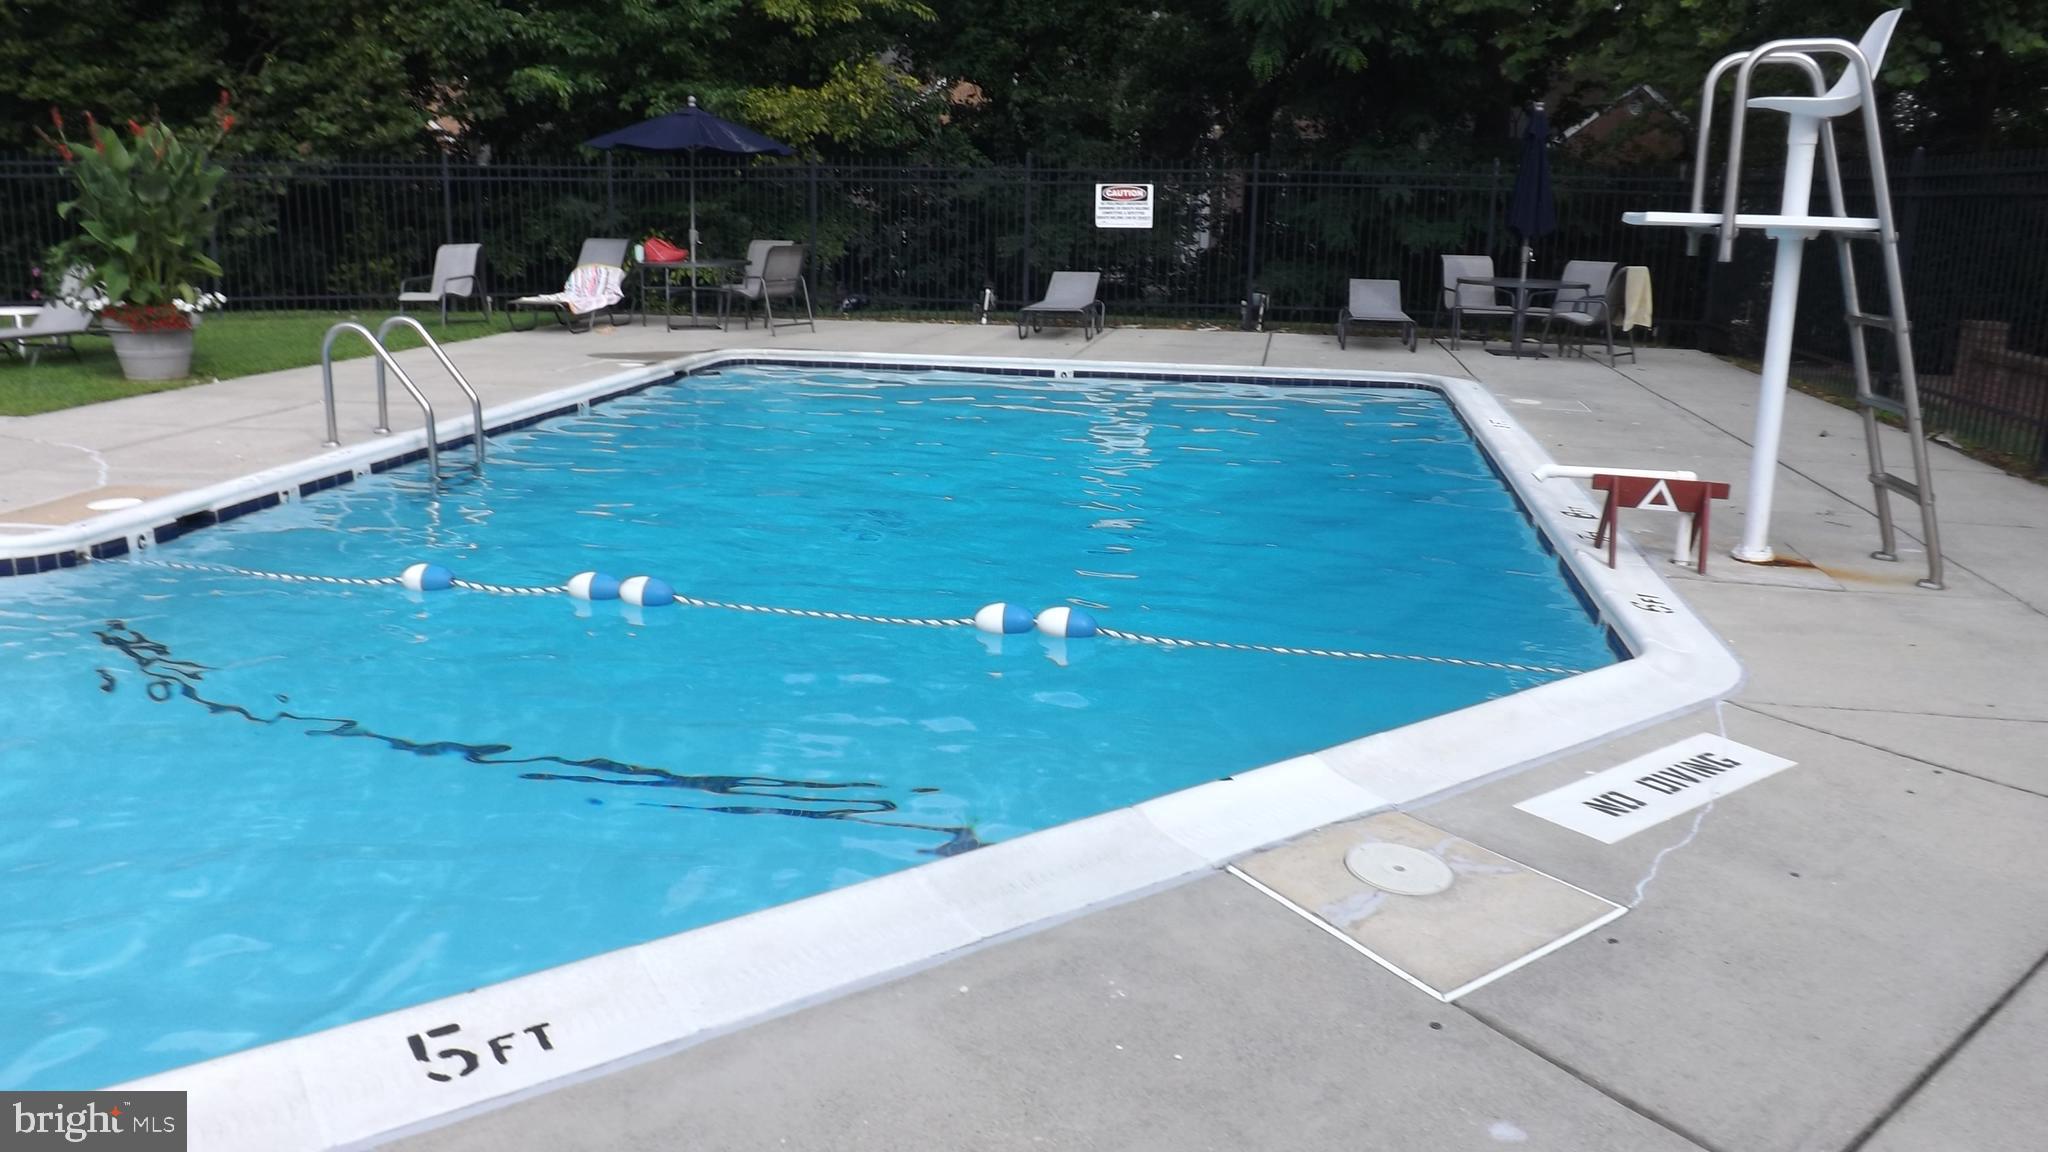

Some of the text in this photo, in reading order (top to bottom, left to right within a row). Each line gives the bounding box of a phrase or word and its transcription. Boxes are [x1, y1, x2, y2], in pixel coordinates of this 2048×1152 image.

[1105, 189, 1144, 197] CAUTION
[1582, 752, 1743, 817] NO DIVING
